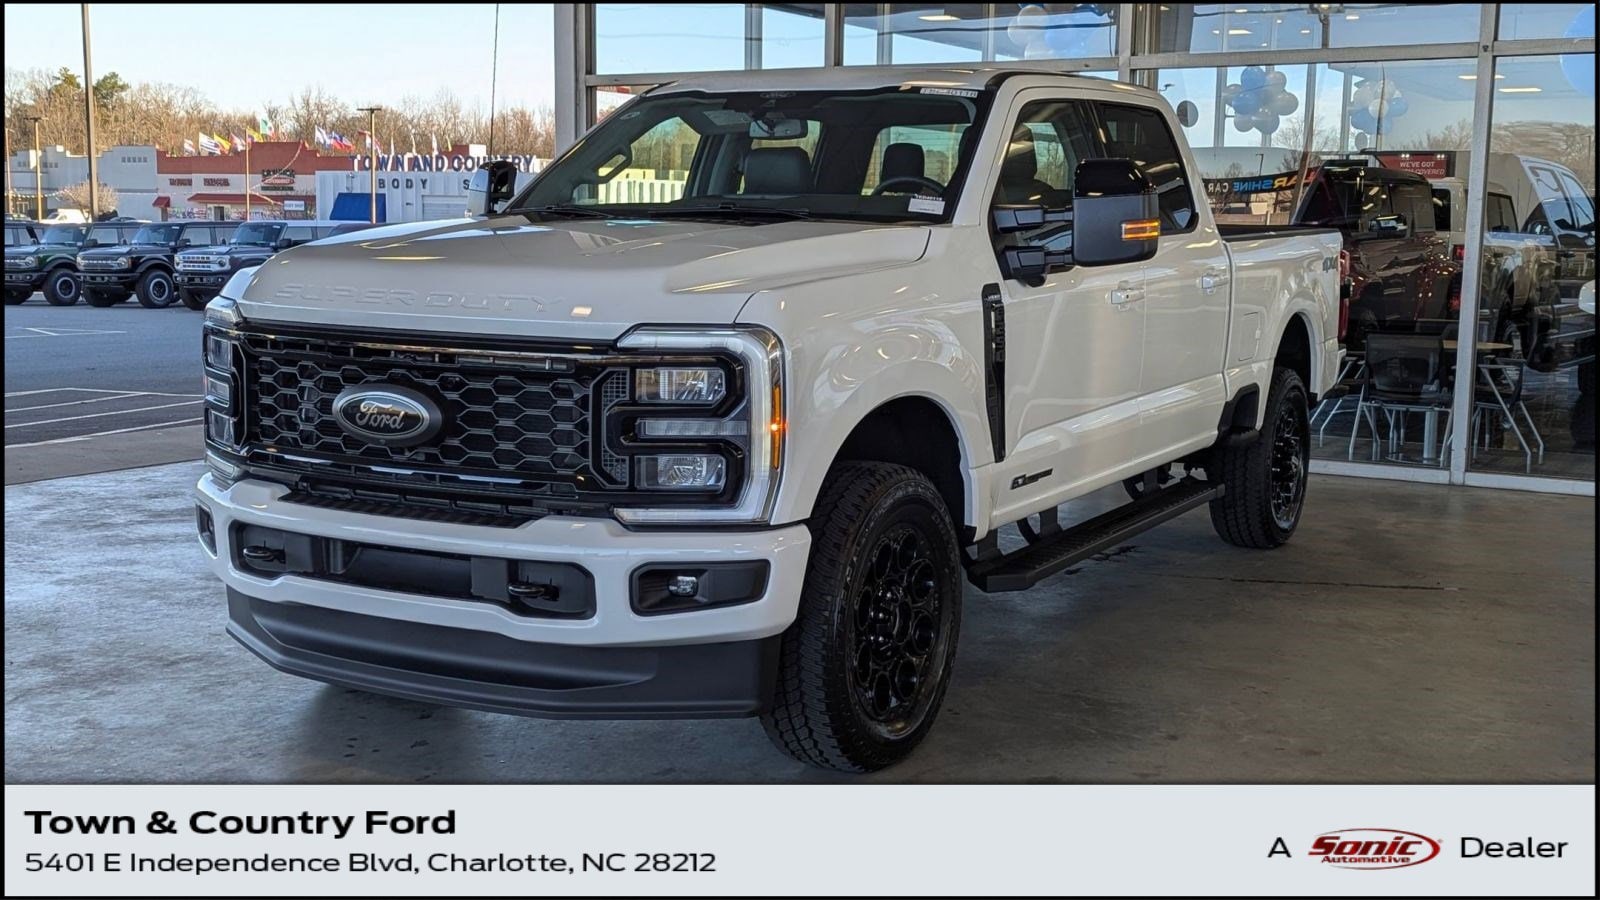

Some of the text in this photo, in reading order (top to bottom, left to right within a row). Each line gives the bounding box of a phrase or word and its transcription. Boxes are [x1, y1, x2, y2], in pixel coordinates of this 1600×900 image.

[350, 154, 404, 171] TOWN
[412, 154, 446, 171] AND
[378, 178, 428, 189] BODY
[273, 282, 566, 312] SUPER DUTY
[356, 400, 407, 429] Ford
